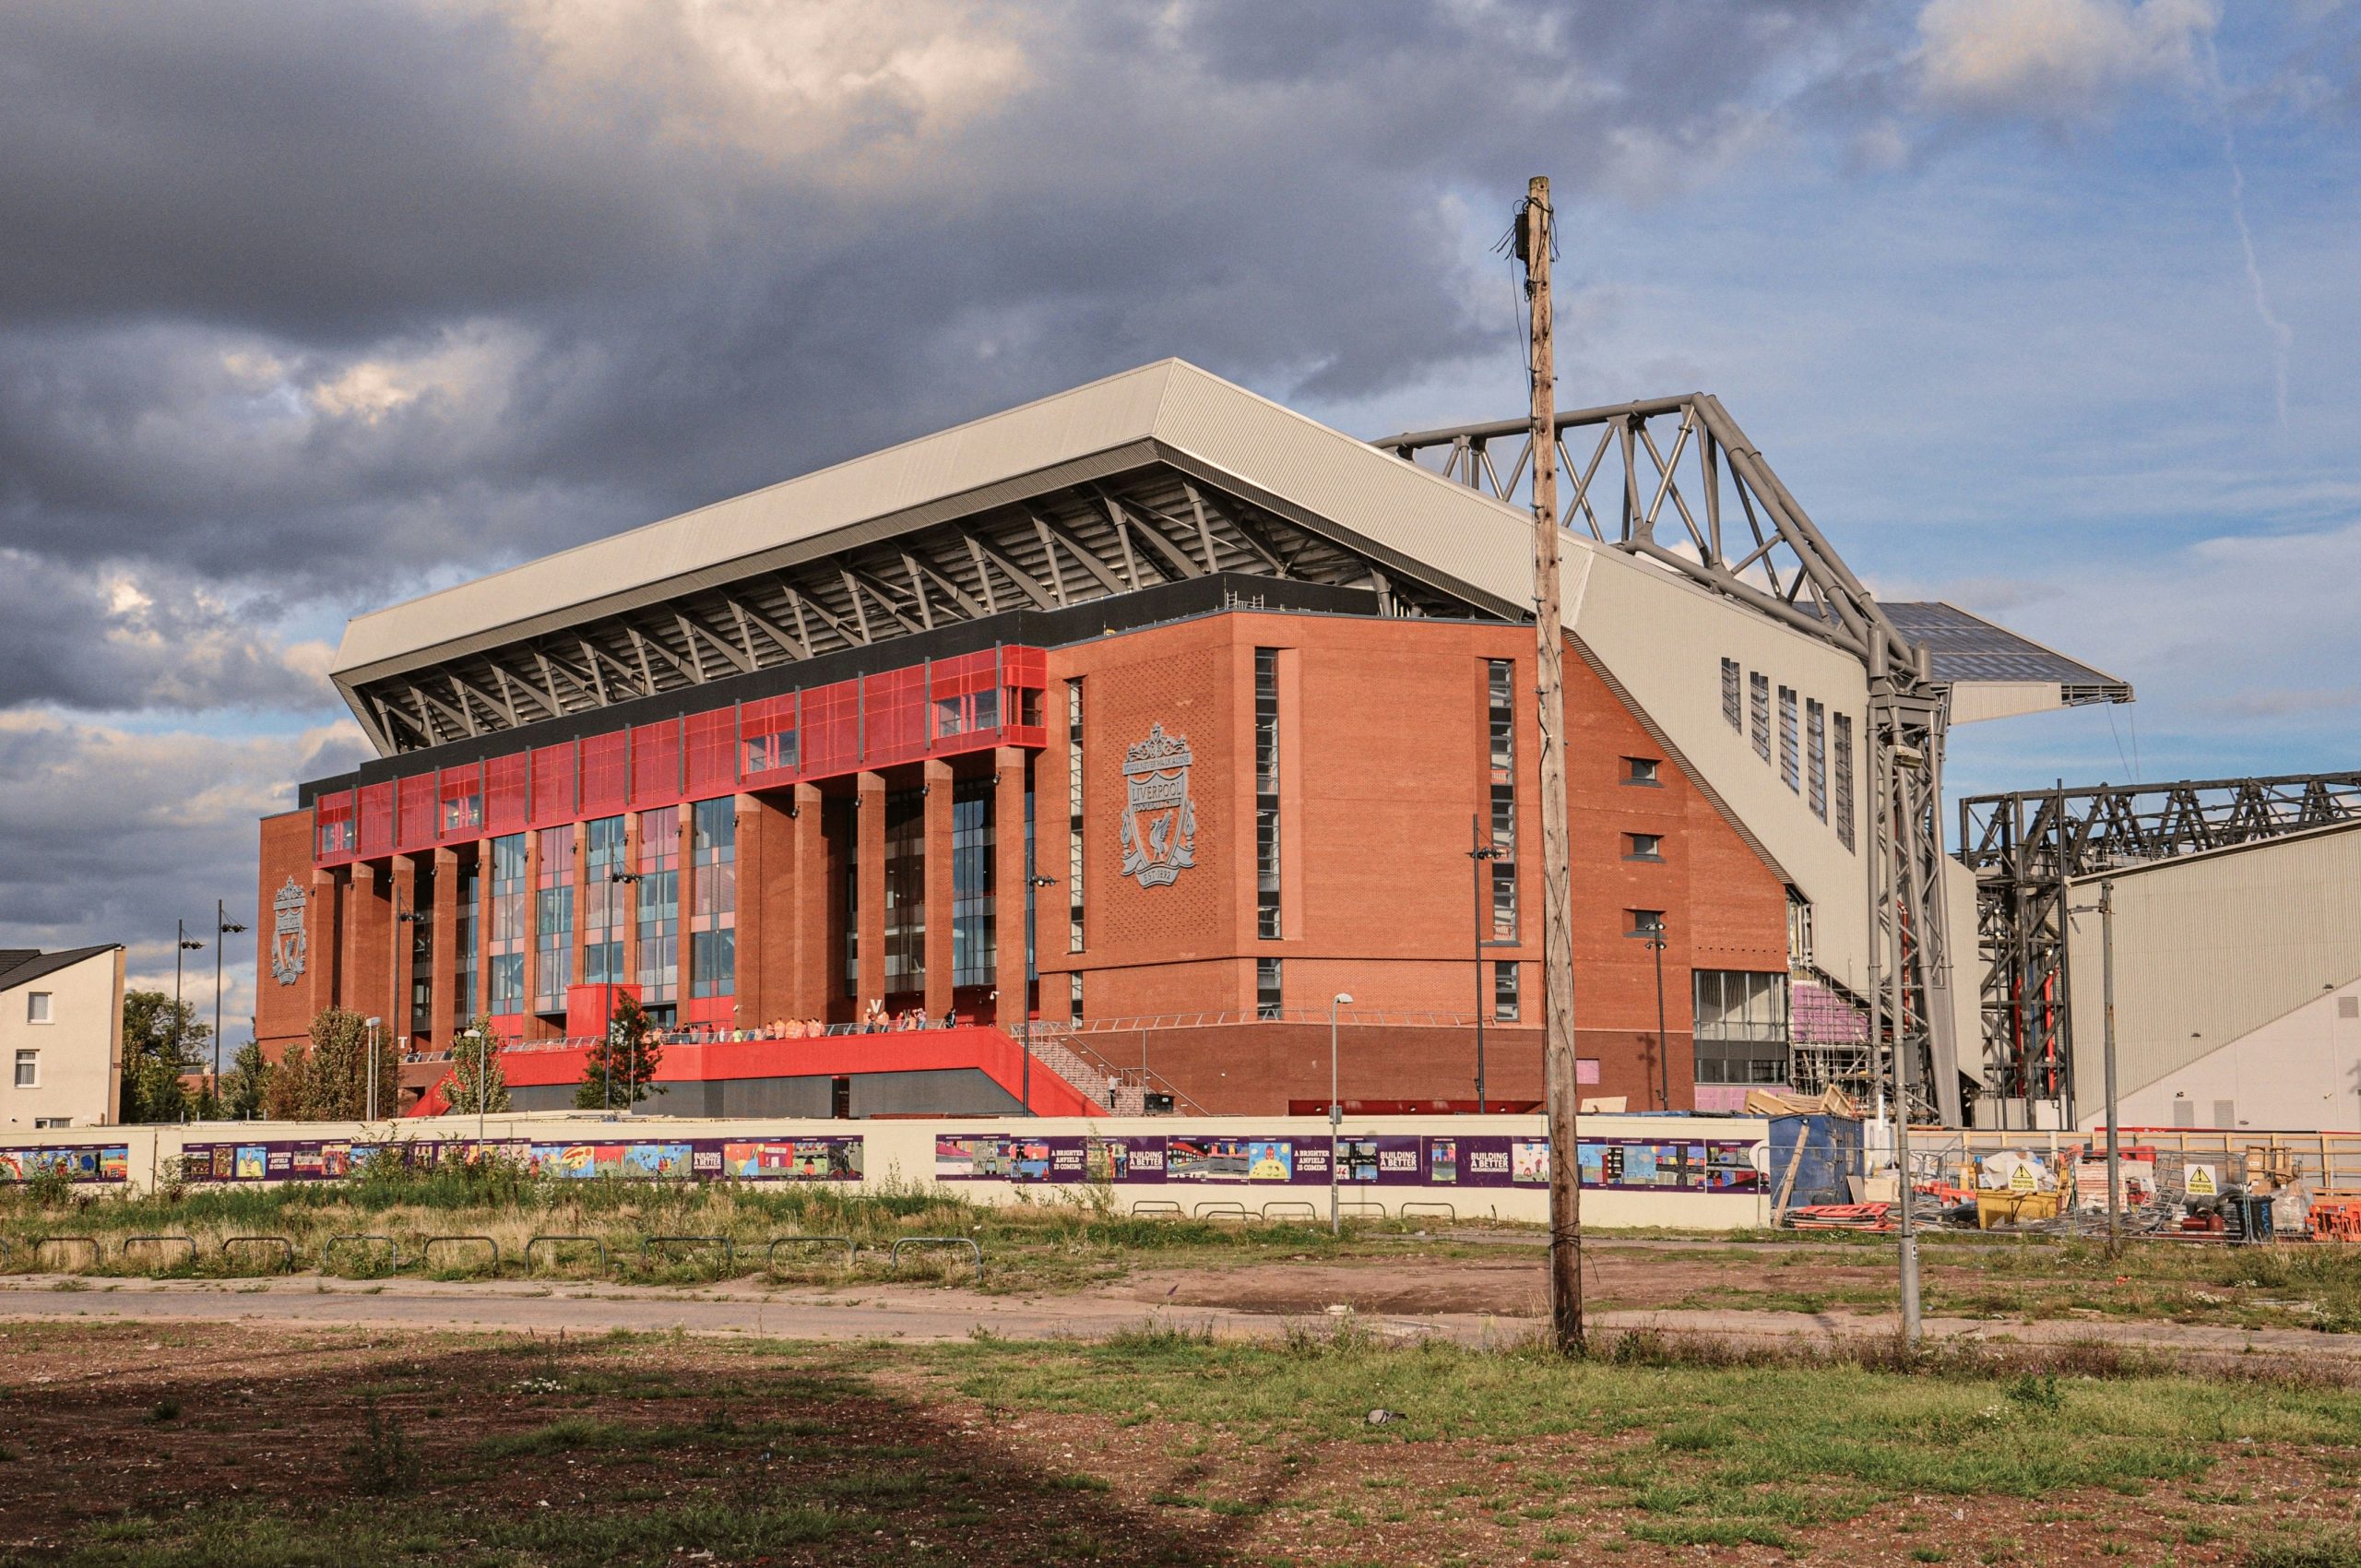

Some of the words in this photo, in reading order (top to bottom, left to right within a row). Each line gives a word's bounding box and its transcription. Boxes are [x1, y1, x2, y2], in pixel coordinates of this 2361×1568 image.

[1132, 781, 1181, 802] LIVERPOOL
[1380, 1151, 1417, 1159] BUILDING
[1470, 1152, 1509, 1160] BUILDING
[1387, 1158, 1417, 1167] BETTER
[1478, 1159, 1509, 1168] BETTER
